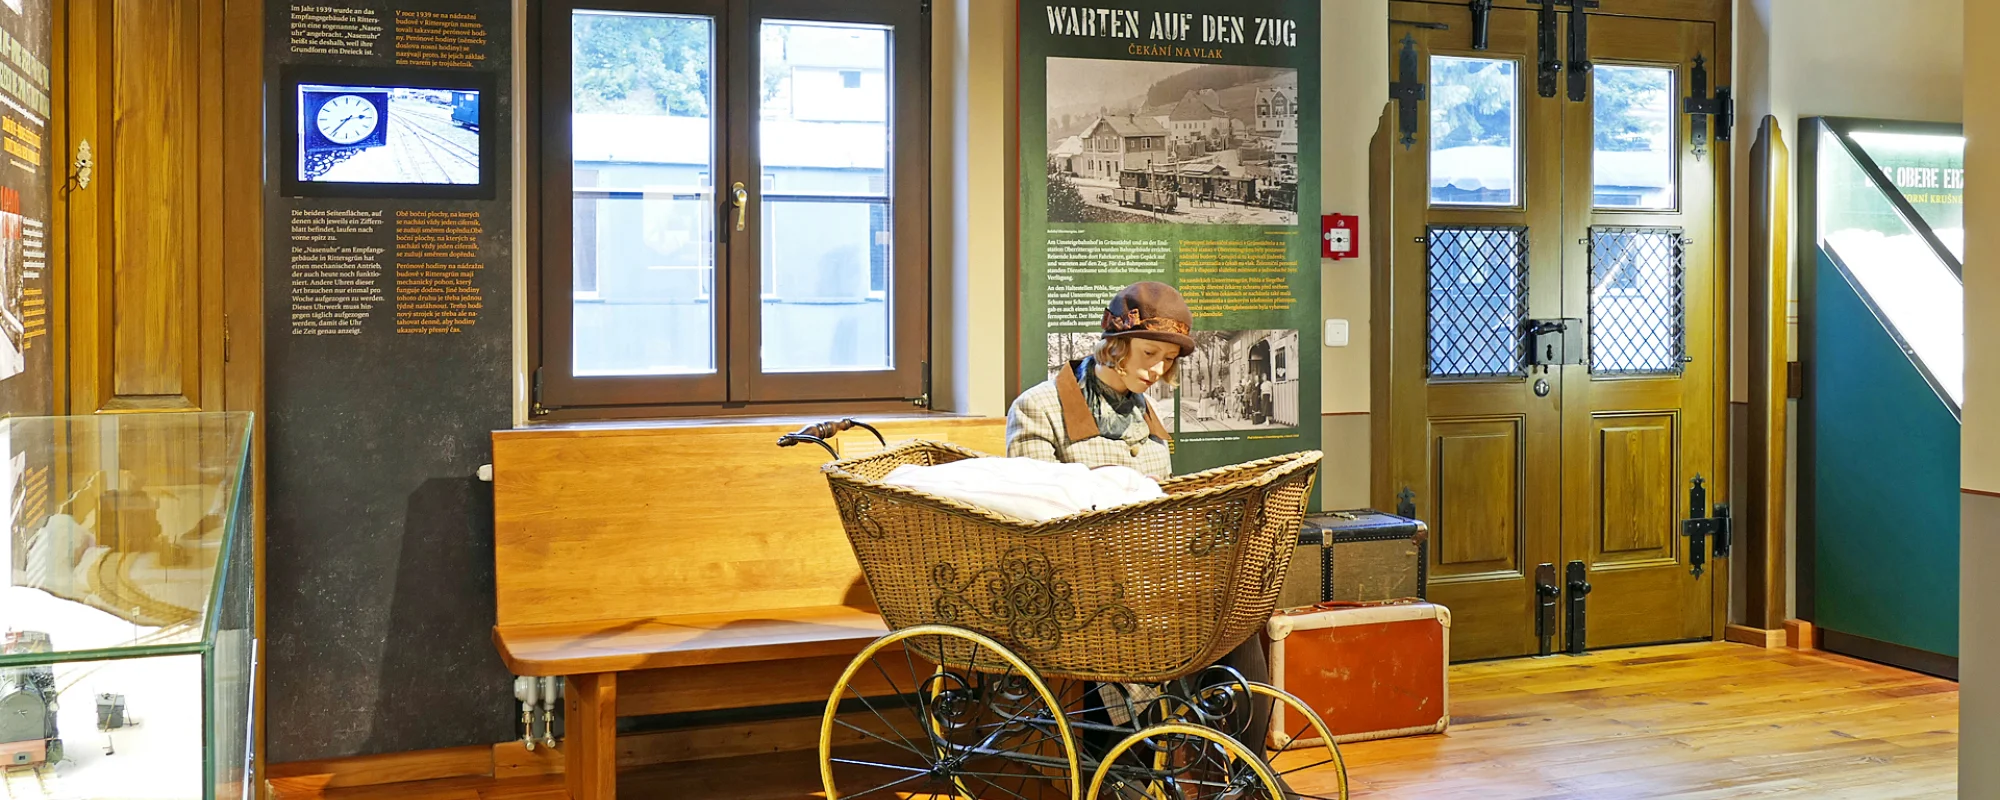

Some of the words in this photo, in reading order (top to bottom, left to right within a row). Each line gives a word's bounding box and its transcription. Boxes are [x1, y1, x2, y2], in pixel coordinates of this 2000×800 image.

[1046, 5, 1139, 39] WARTEN
[1149, 12, 1193, 41] AUF
[1202, 14, 1244, 44] DEN
[1254, 17, 1297, 48] ZUG
[1128, 43, 1172, 57] ČEKÁNÍ
[1175, 46, 1190, 57] NA
[1193, 46, 1223, 59] VLAK
[1896, 166, 1939, 188] OBERE
